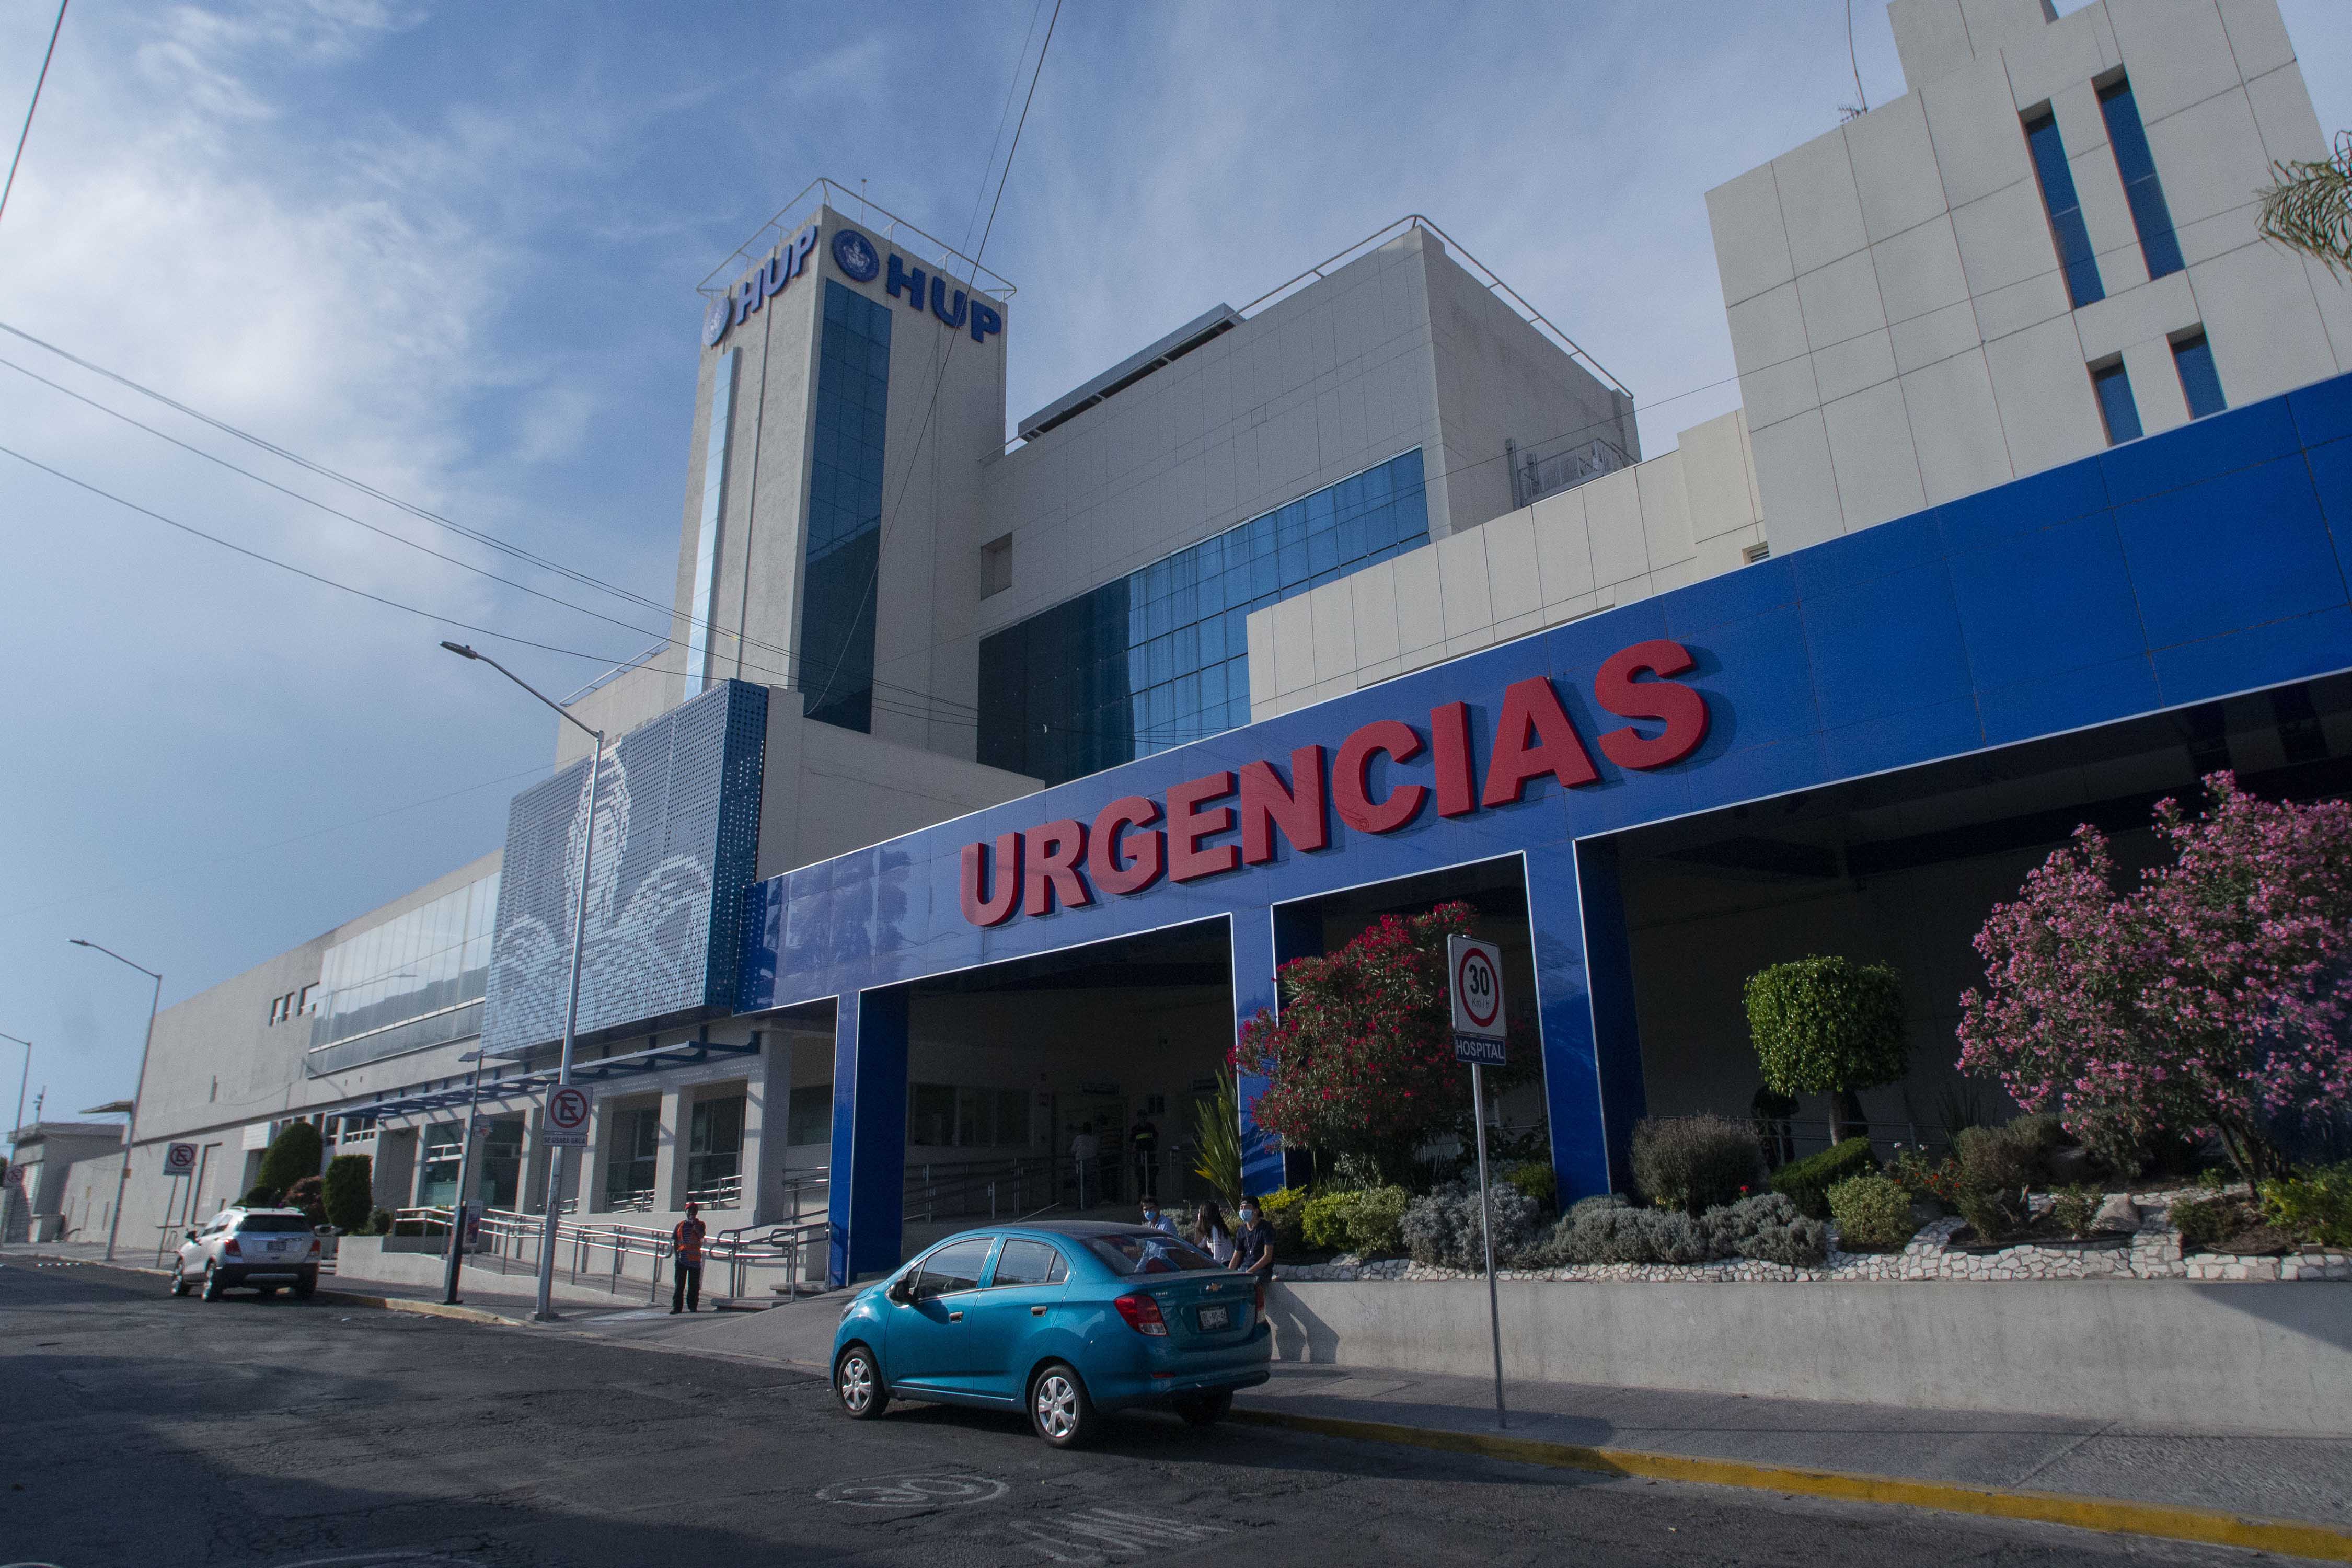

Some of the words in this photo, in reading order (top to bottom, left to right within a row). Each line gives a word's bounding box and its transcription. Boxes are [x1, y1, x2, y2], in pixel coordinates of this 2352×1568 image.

[735, 225, 818, 326] HUP
[885, 253, 1002, 343] HUP
[959, 638, 1710, 928] URGENCIAS
[1468, 964, 1490, 996] 30
[1456, 1039, 1505, 1059] HOSPITAL
